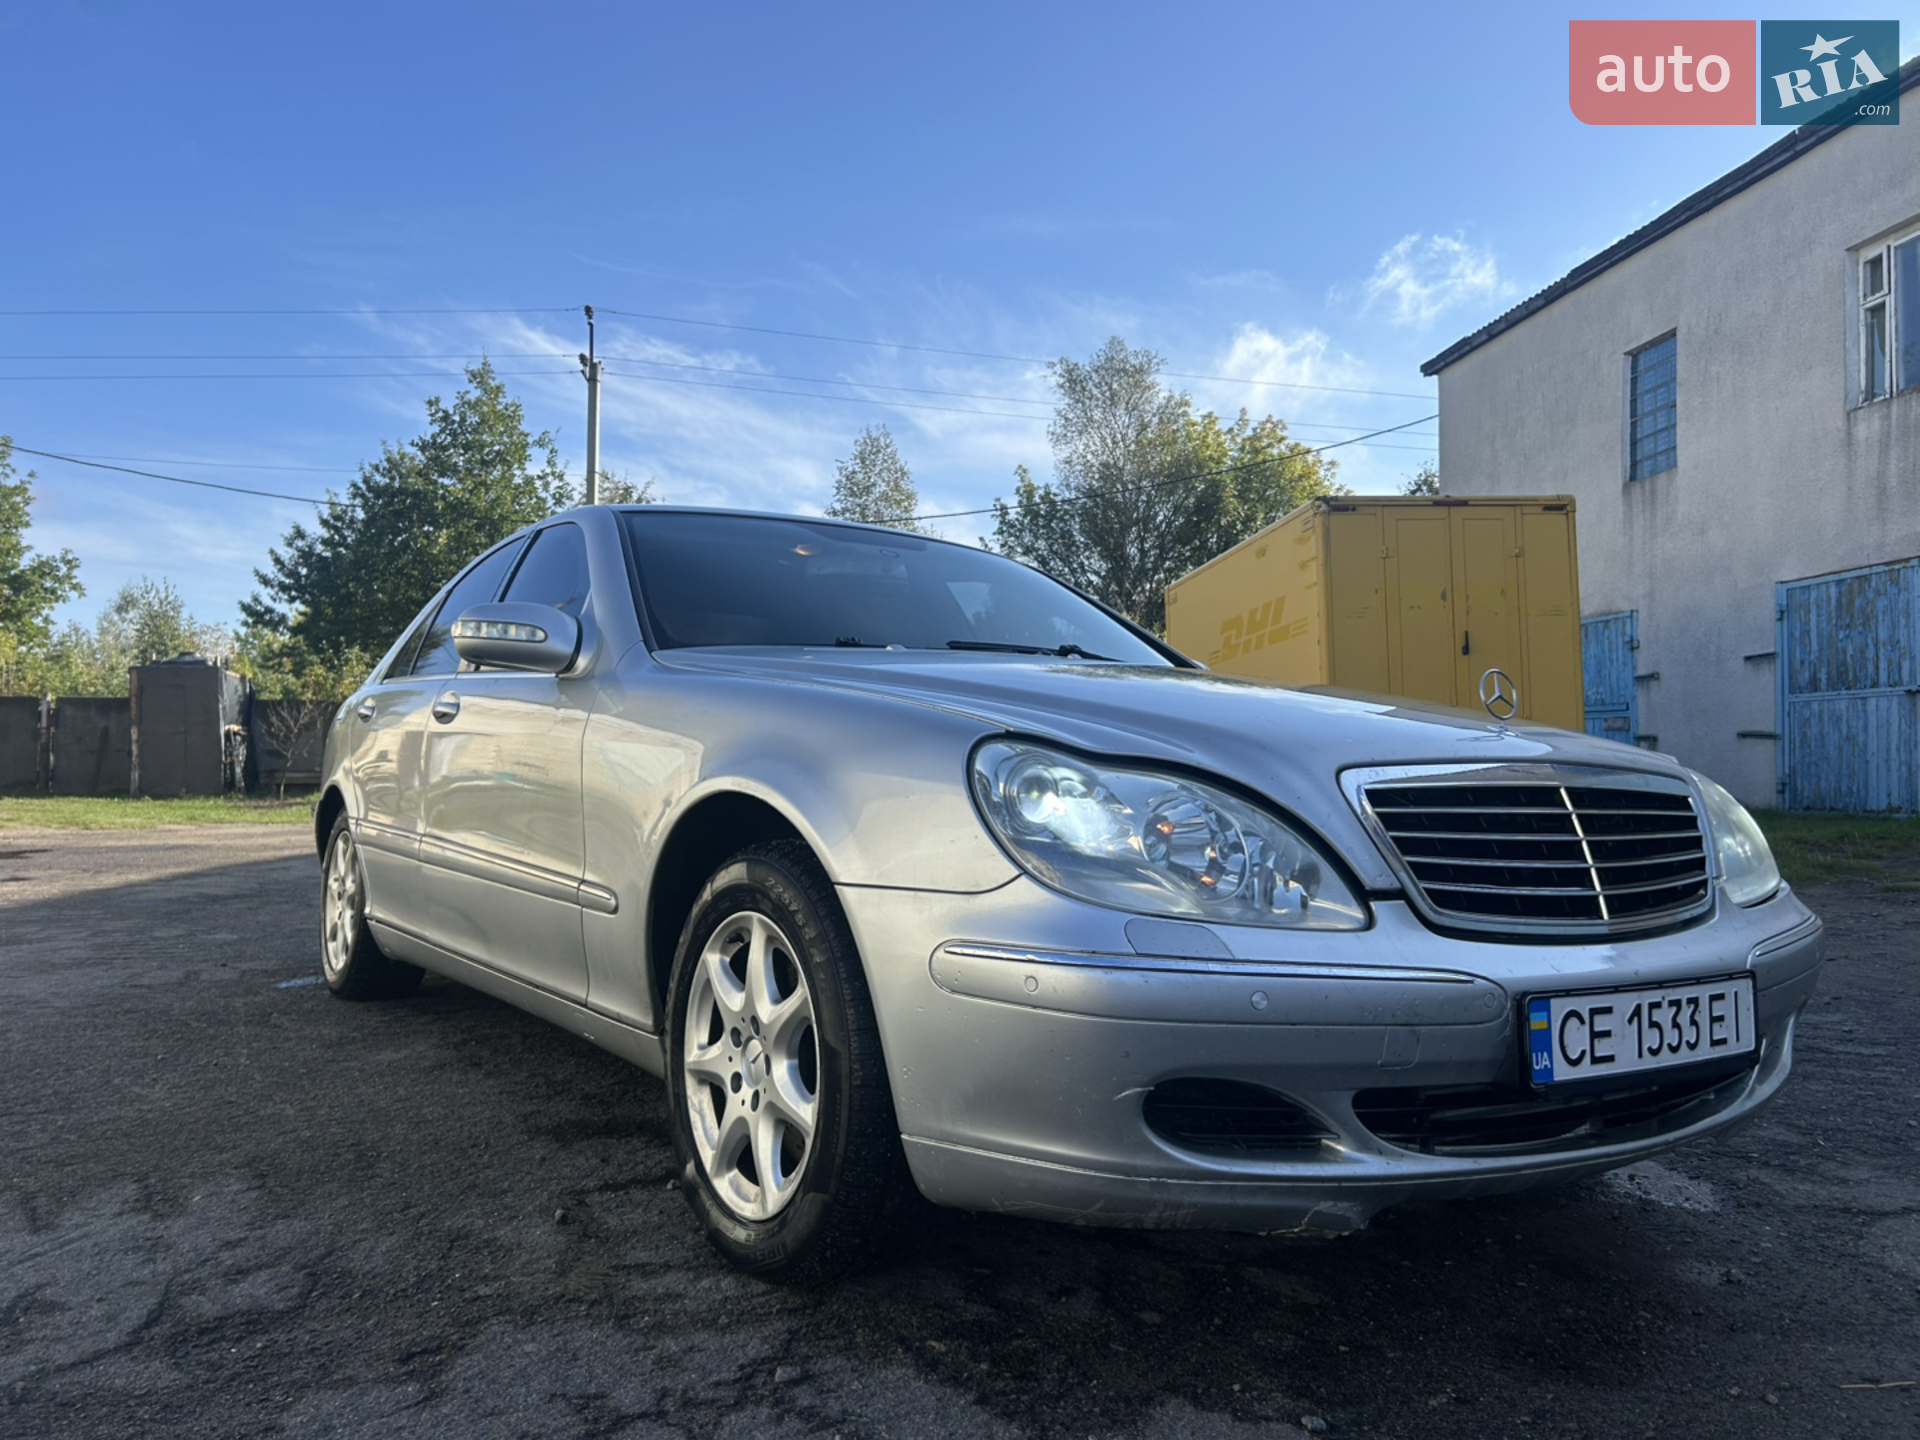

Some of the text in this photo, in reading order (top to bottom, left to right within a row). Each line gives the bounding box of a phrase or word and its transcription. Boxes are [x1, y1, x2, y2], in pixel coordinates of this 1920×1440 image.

[1219, 594, 1292, 663] DHL
[1532, 1051, 1551, 1070] UA
[1557, 989, 1741, 1068] CE 1533 EI
